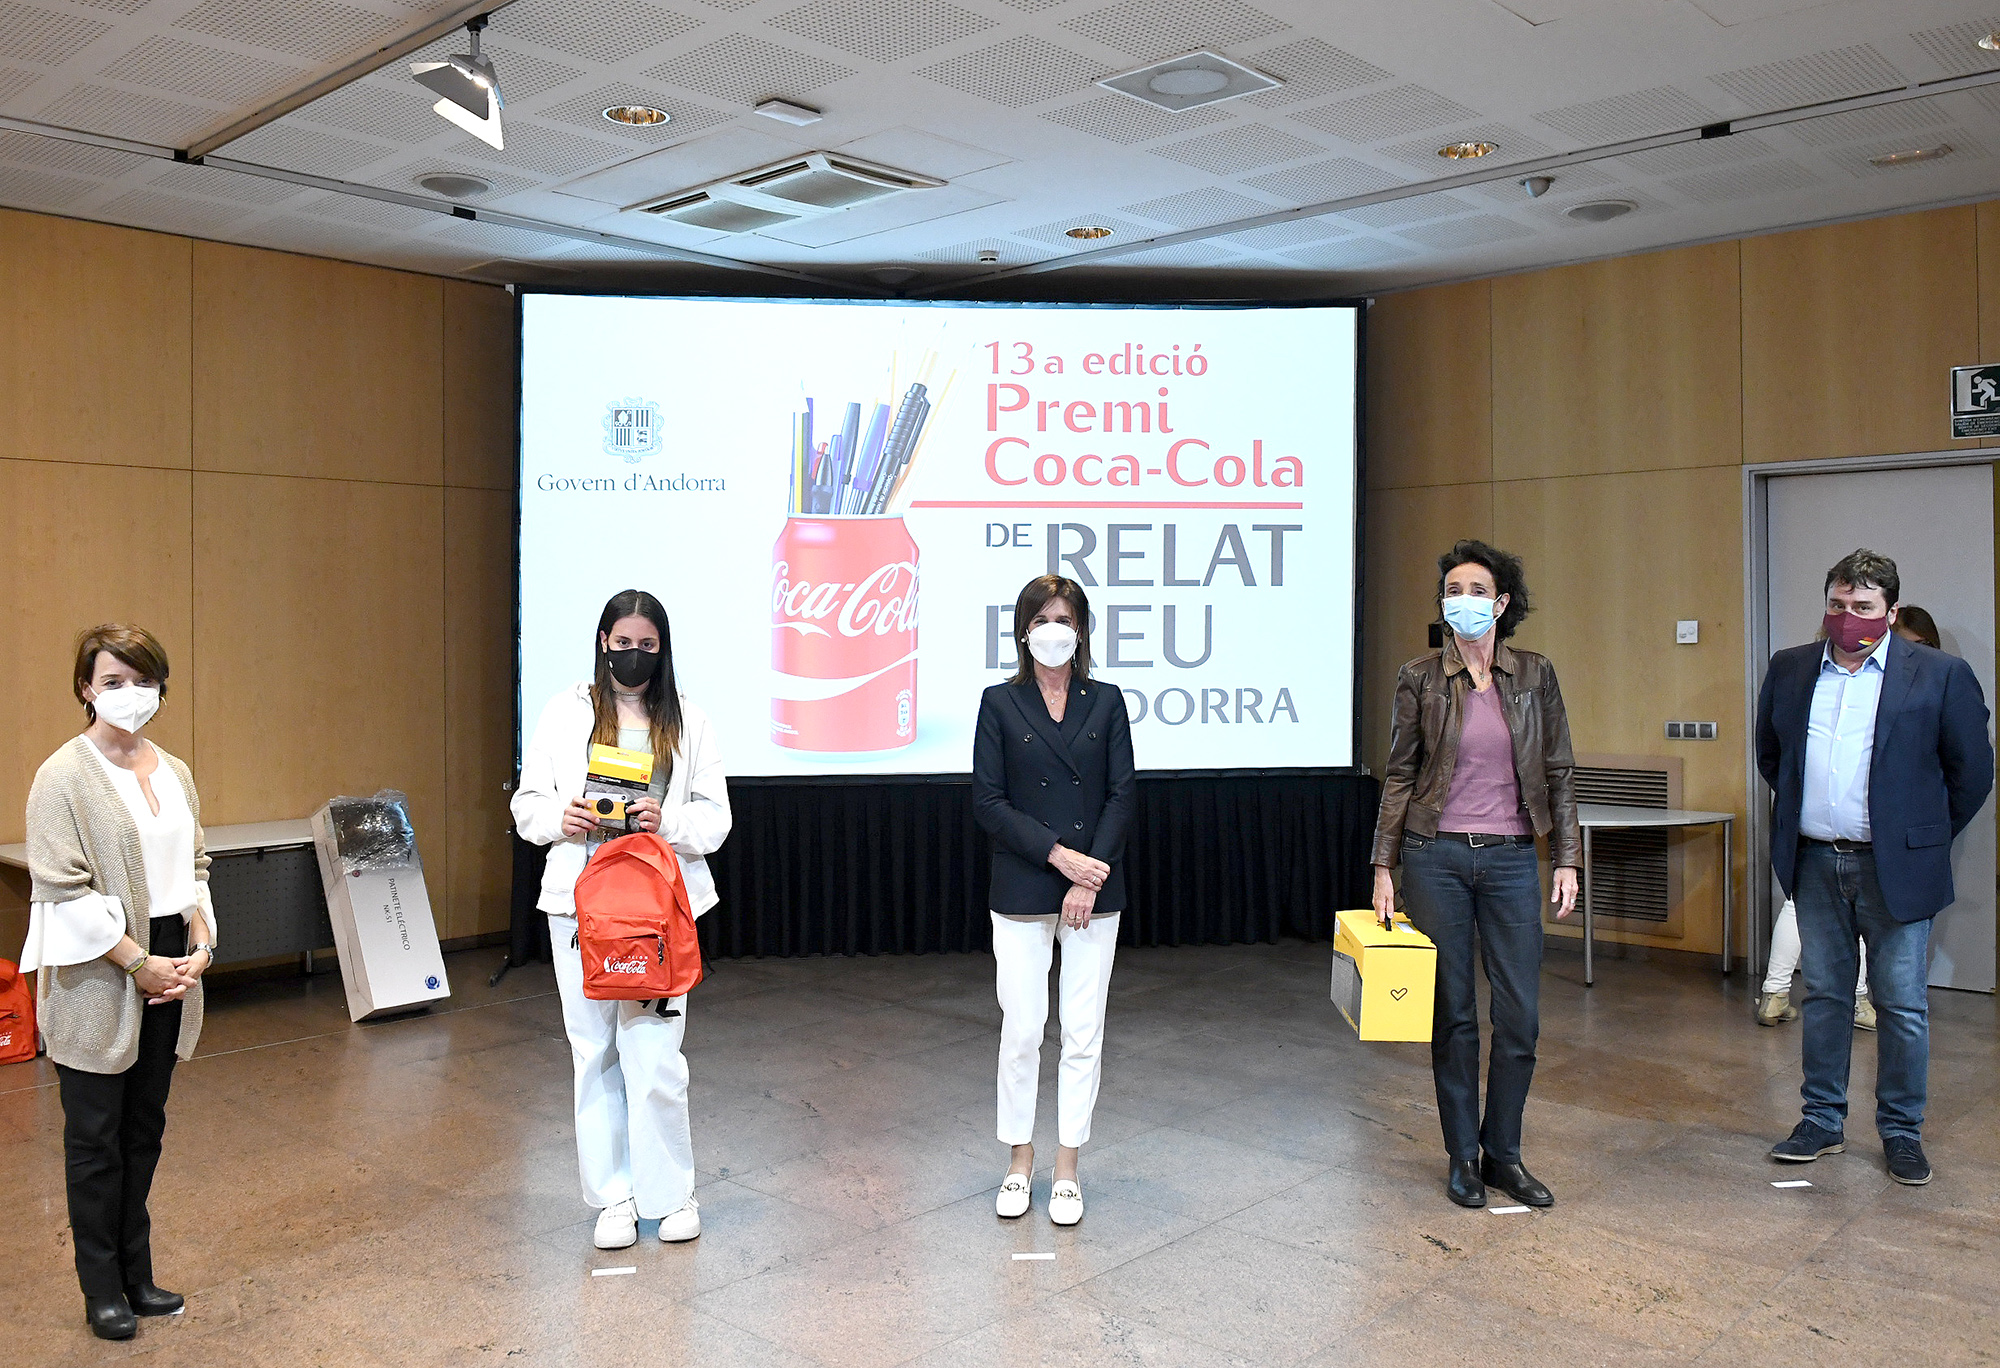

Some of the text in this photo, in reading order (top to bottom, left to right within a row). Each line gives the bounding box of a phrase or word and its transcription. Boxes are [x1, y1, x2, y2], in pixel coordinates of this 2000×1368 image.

[1082, 342, 1209, 376] edició
[986, 383, 1174, 433] Premi
[984, 436, 1304, 487] Coca-Cola
[537, 473, 726, 492] Govern d'Andorra
[985, 522, 1303, 587] DE RELAT
[985, 604, 1213, 669] BEU
[1122, 687, 1300, 726] DORRA
[383, 904, 393, 923] NK-S1
[388, 878, 401, 911] PATINETE
